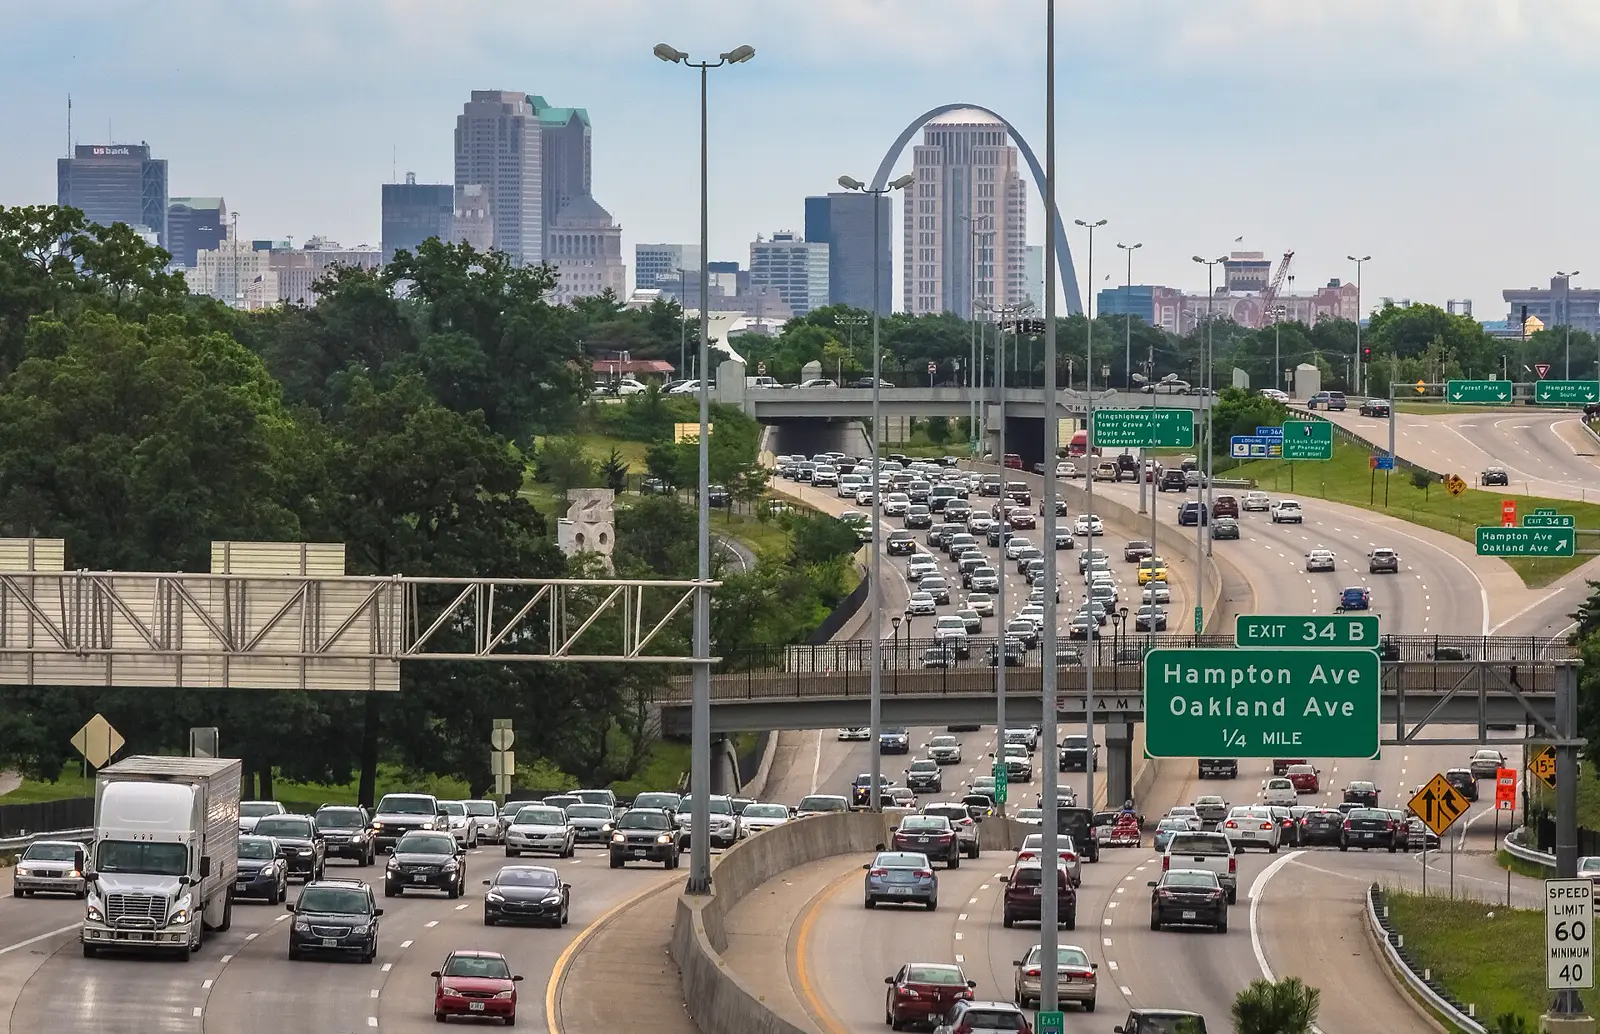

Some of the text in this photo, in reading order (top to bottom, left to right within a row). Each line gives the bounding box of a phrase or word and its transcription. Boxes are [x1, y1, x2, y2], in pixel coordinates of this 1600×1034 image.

[1482, 532, 1528, 542] Hampton
[1482, 544, 1524, 552] Oakland
[1249, 622, 1364, 641] EXIT 34 B
[1164, 664, 1361, 688] Hampton Ave
[1170, 696, 1354, 717] Oakland Ave
[1262, 732, 1302, 745] MILE
[1550, 888, 1590, 898] SPEED
[1554, 904, 1585, 916] LIMIT
[1555, 920, 1586, 942] 60
[1552, 948, 1590, 958] MINIMUM
[1559, 964, 1583, 982] 40
[1042, 1016, 1060, 1025] EAST
